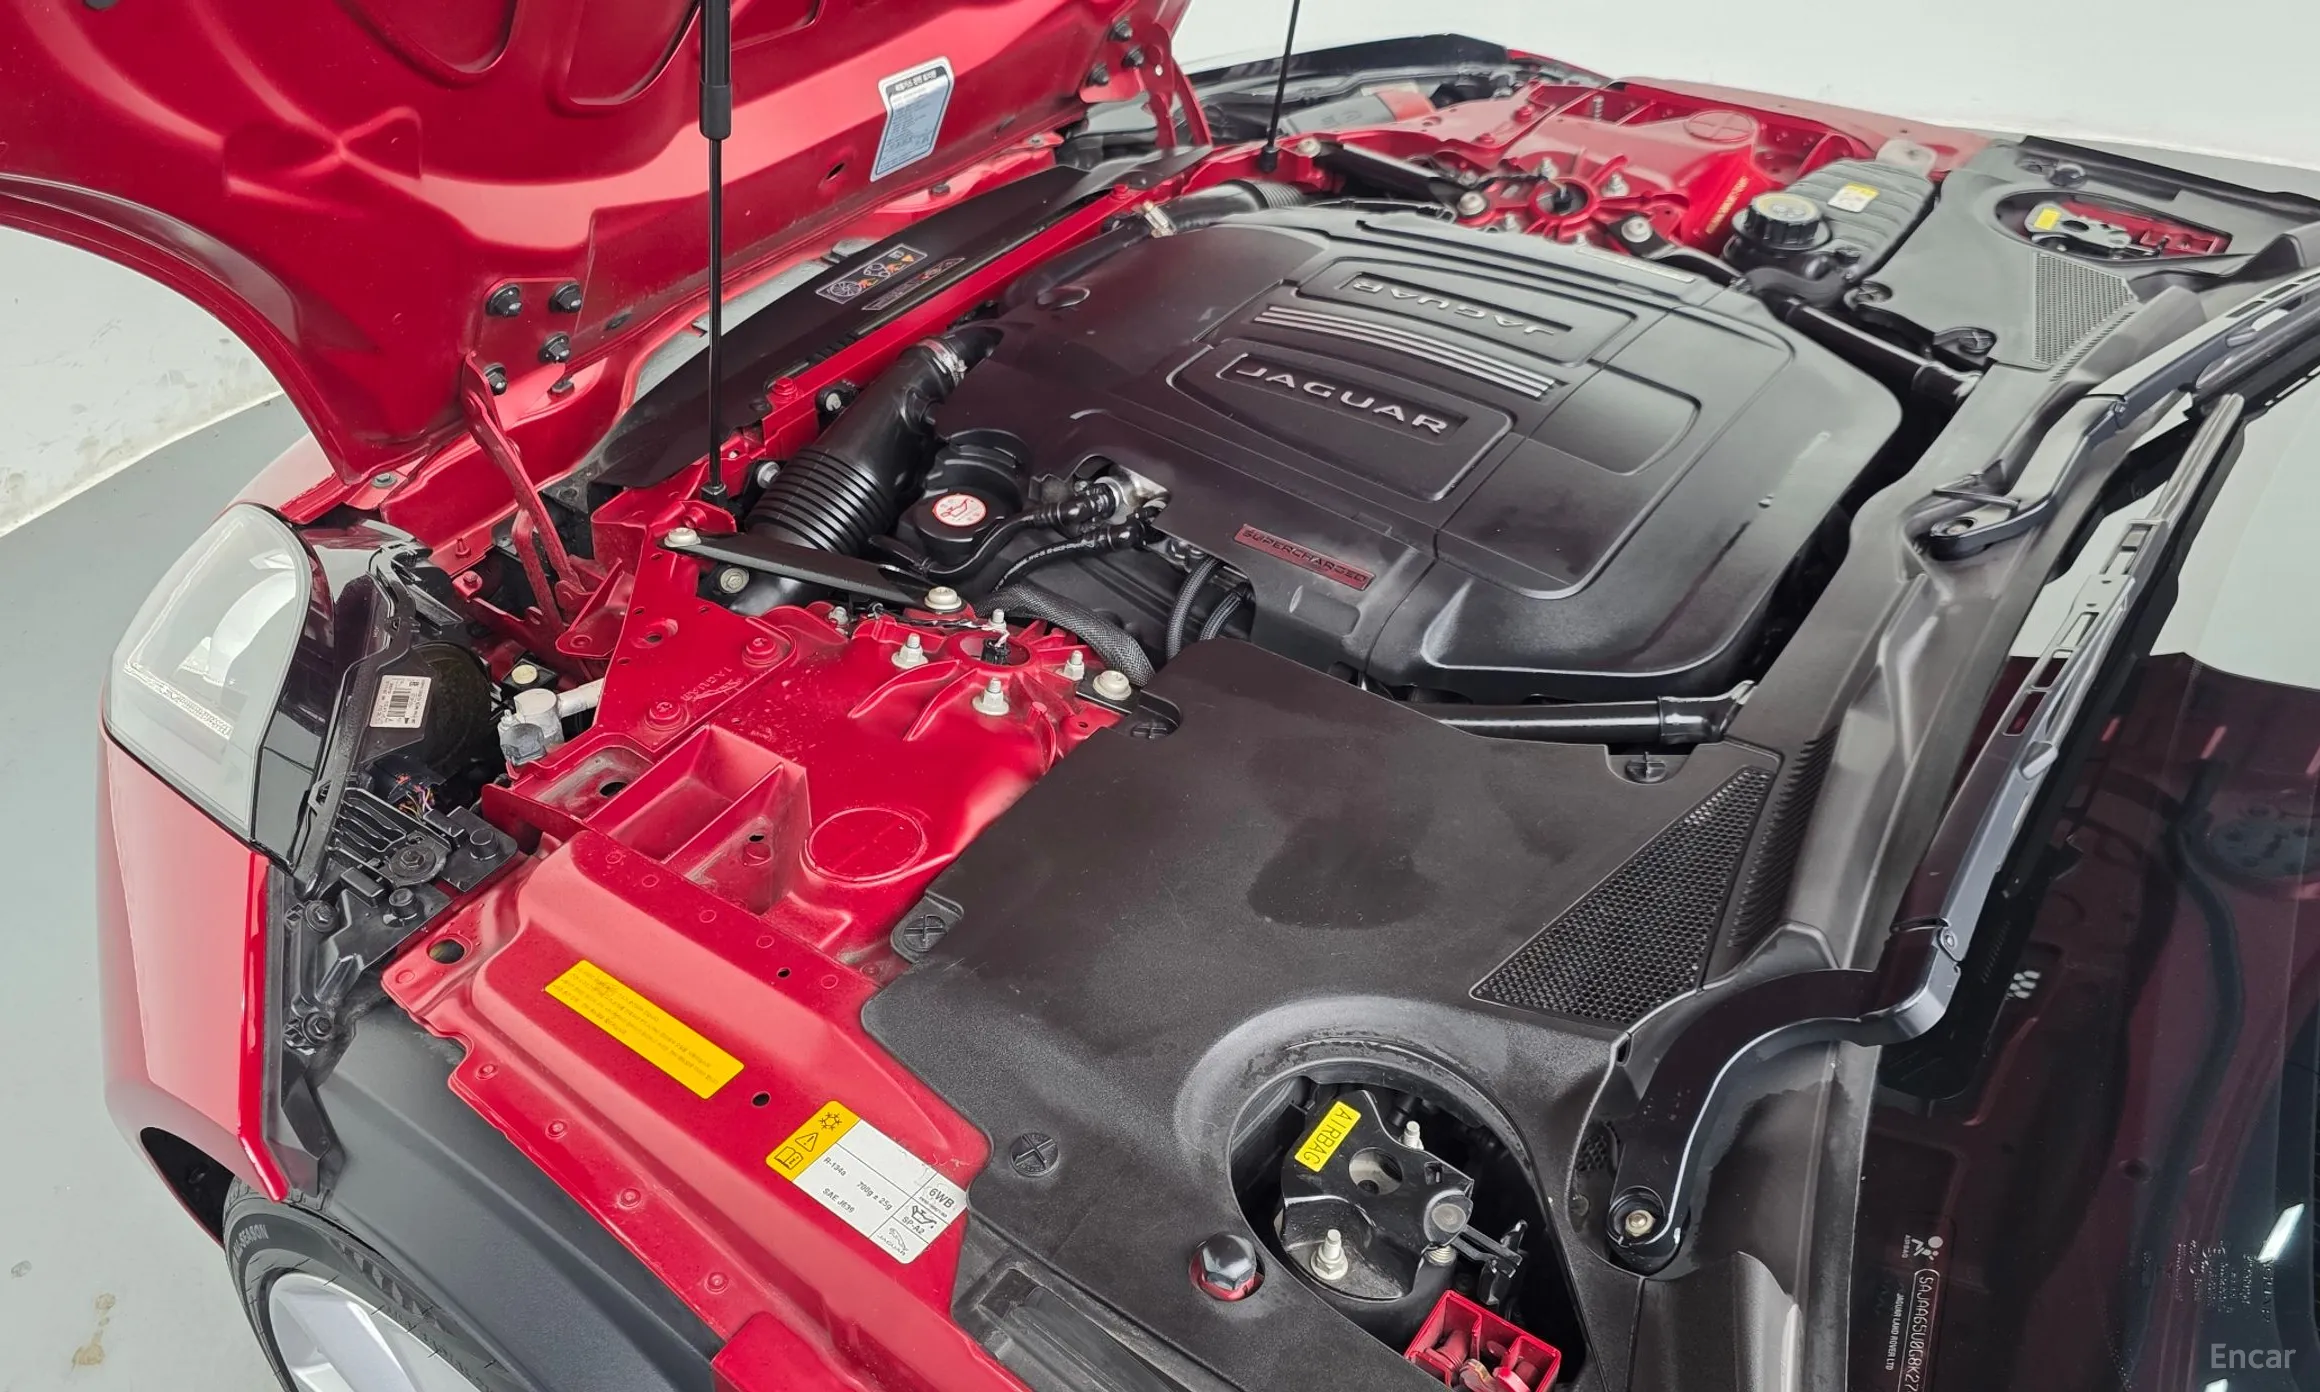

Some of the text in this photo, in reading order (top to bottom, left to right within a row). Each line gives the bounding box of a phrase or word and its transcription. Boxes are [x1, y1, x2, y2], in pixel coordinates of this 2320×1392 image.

[1353, 280, 1555, 336] JAGUAR
[1235, 367, 1448, 434] JAGUAR
[1241, 528, 1369, 583] SUPERCHARGED
[1303, 1107, 1353, 1165] AIRBAG
[822, 1156, 847, 1177] R-134a
[822, 1187, 838, 1202] SAE
[879, 1196, 893, 1211] 25g
[928, 1187, 956, 1209] 6WB
[901, 1215, 926, 1235] SP-A2
[877, 1233, 907, 1257] JAGUAR
[1893, 1293, 1905, 1317] JAGUAR
[1904, 1276, 1934, 1392] SAJAA65U0G8K27
[1885, 1358, 1894, 1371] LTD
